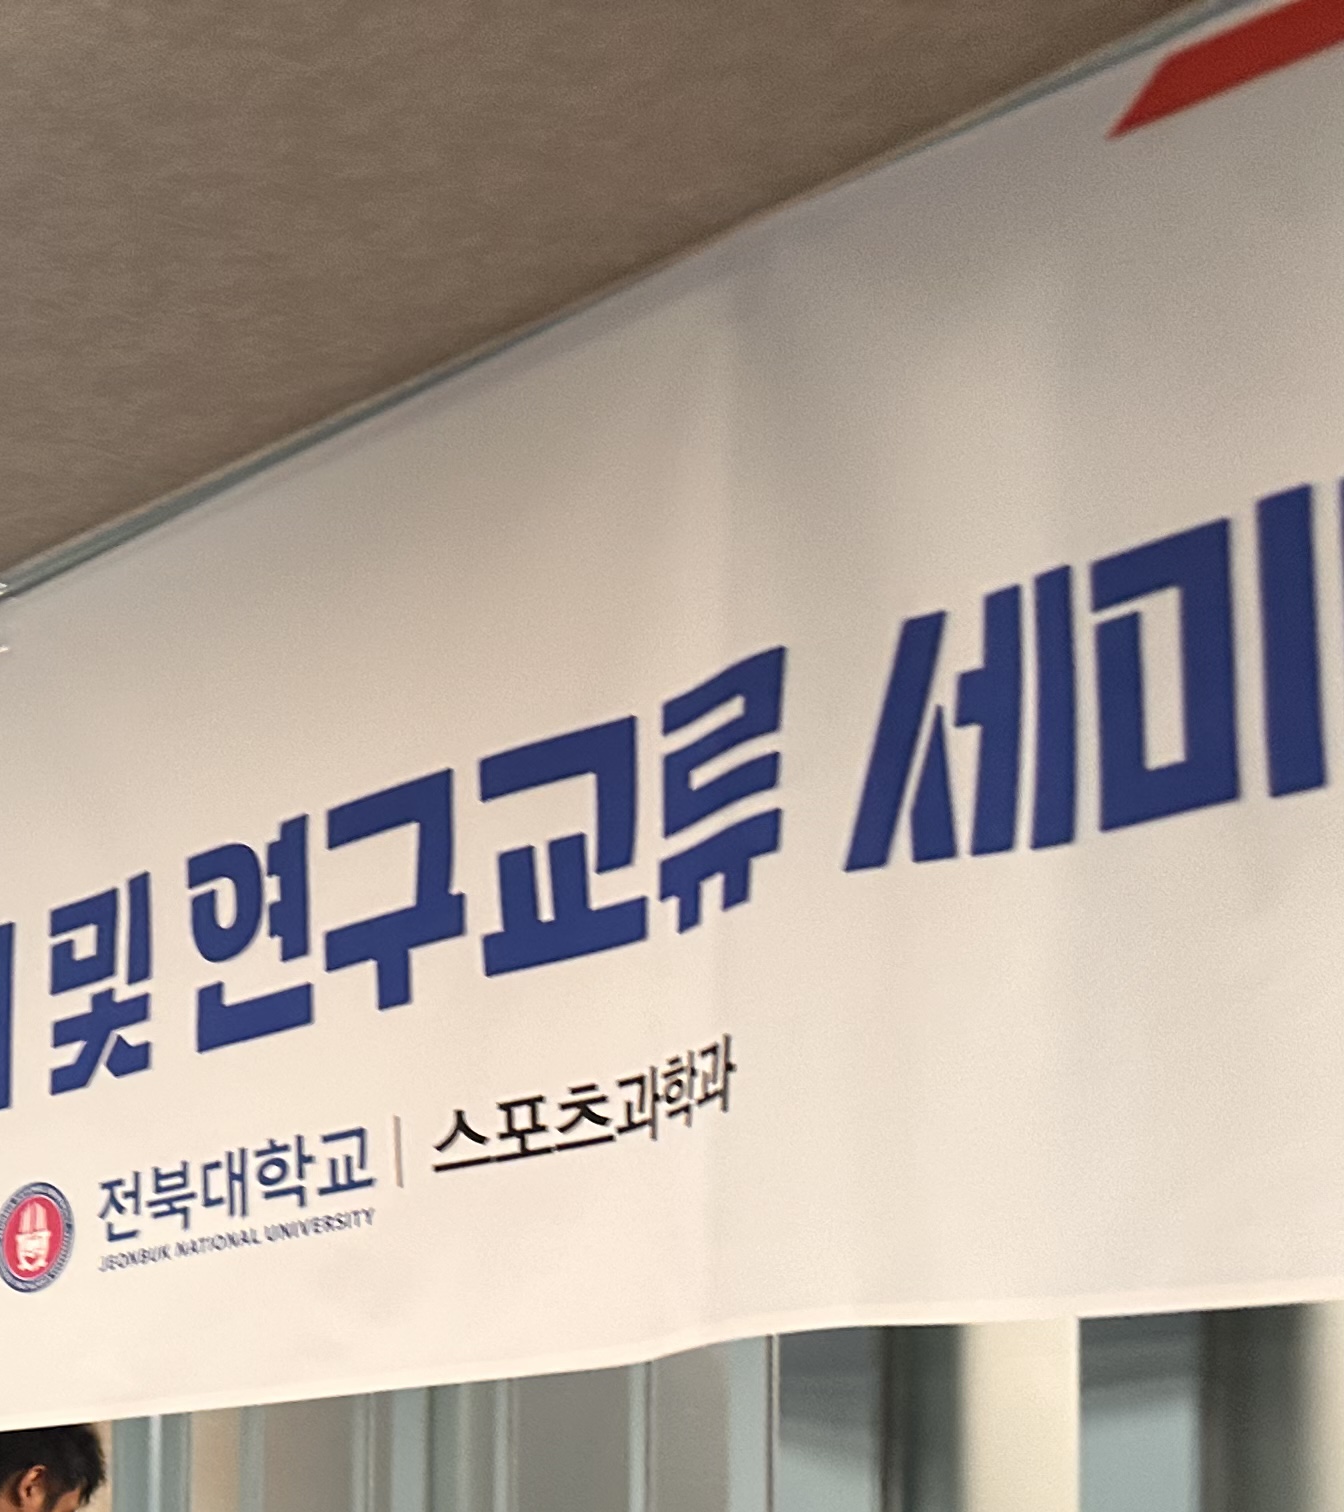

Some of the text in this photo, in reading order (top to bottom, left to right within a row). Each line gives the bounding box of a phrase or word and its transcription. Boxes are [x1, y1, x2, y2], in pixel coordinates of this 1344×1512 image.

[49, 871, 153, 1097] 및
[186, 645, 787, 1054] 연구교류
[843, 475, 1344, 873] 세미
[97, 1126, 378, 1243] 전북대학교
[432, 1033, 738, 1172] 스포츠과학과
[174, 1225, 261, 1259] NATIONAL
[263, 1207, 377, 1245] UNIVERSITY
